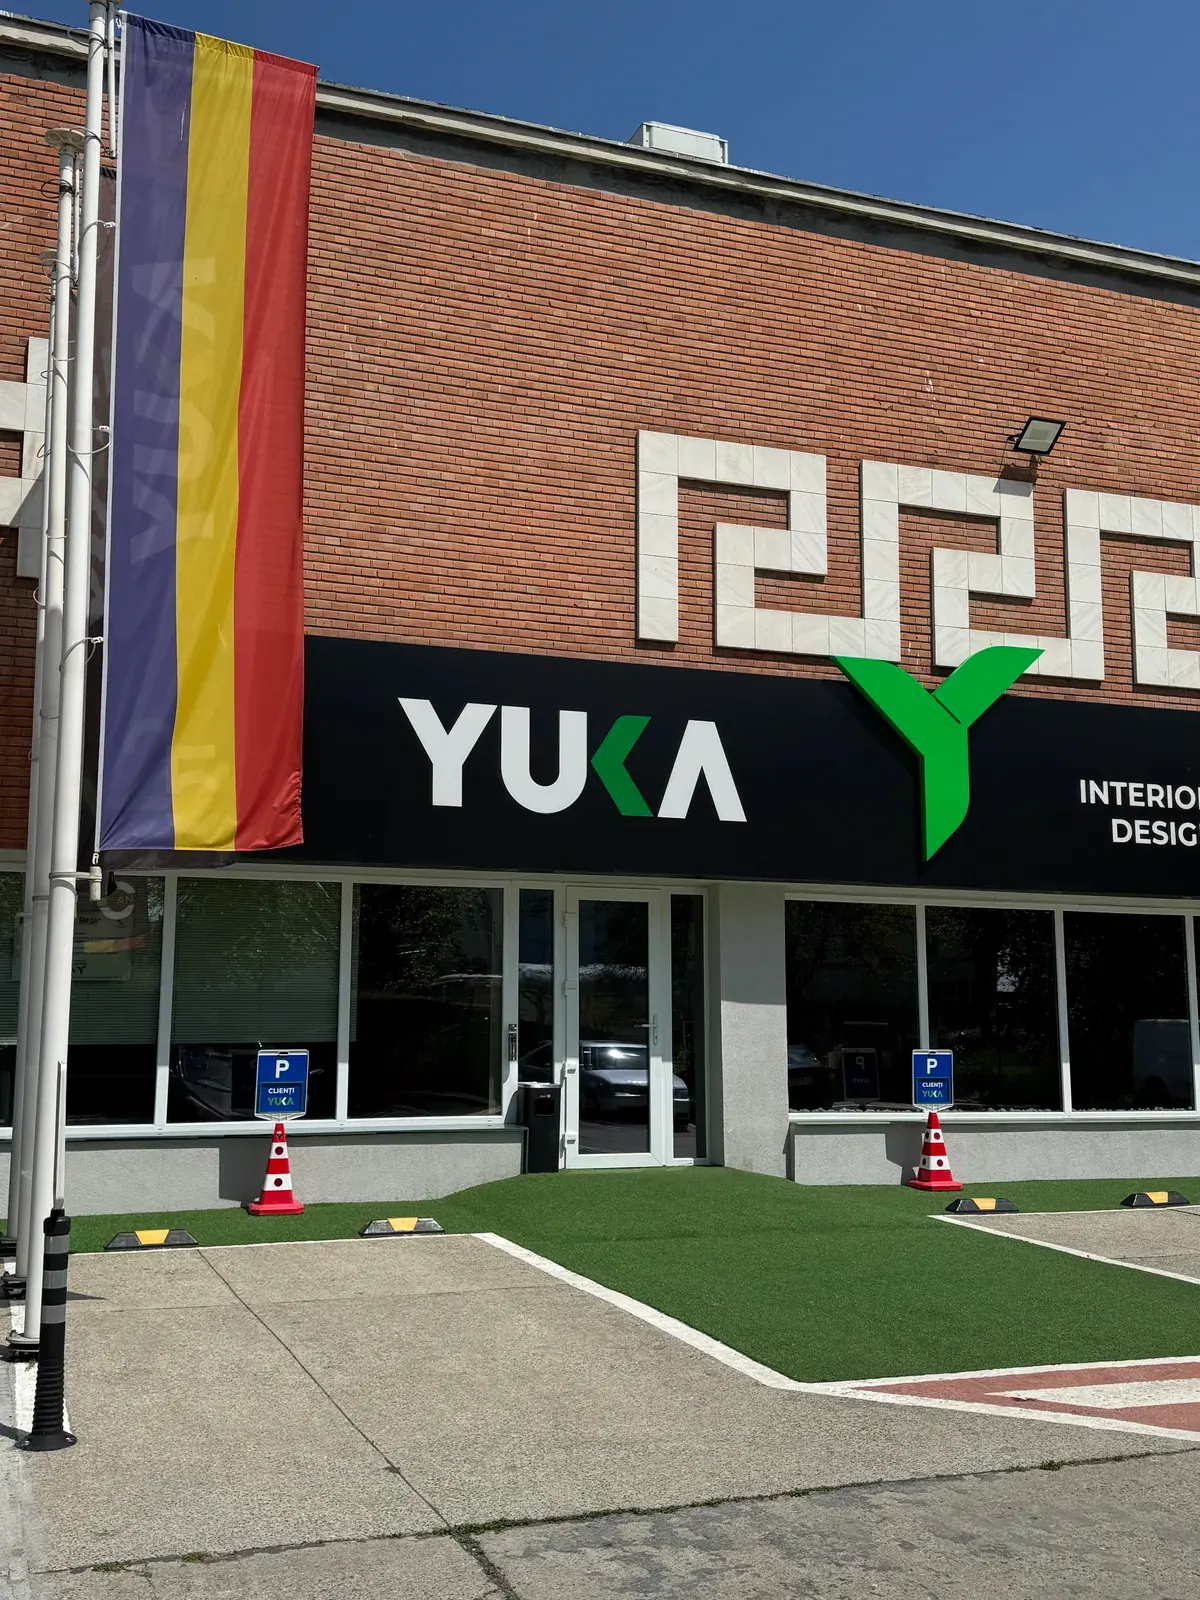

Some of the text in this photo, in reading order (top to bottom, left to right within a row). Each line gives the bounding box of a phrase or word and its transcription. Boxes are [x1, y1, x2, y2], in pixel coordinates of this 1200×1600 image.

[398, 697, 748, 822] YUKA
[1080, 779, 1200, 810] INTERIO
[1111, 818, 1200, 847] DESIG
[275, 1059, 290, 1079] P
[926, 1058, 938, 1075] P
[268, 1097, 294, 1106] YUKA
[922, 1090, 943, 1098] YUKA
